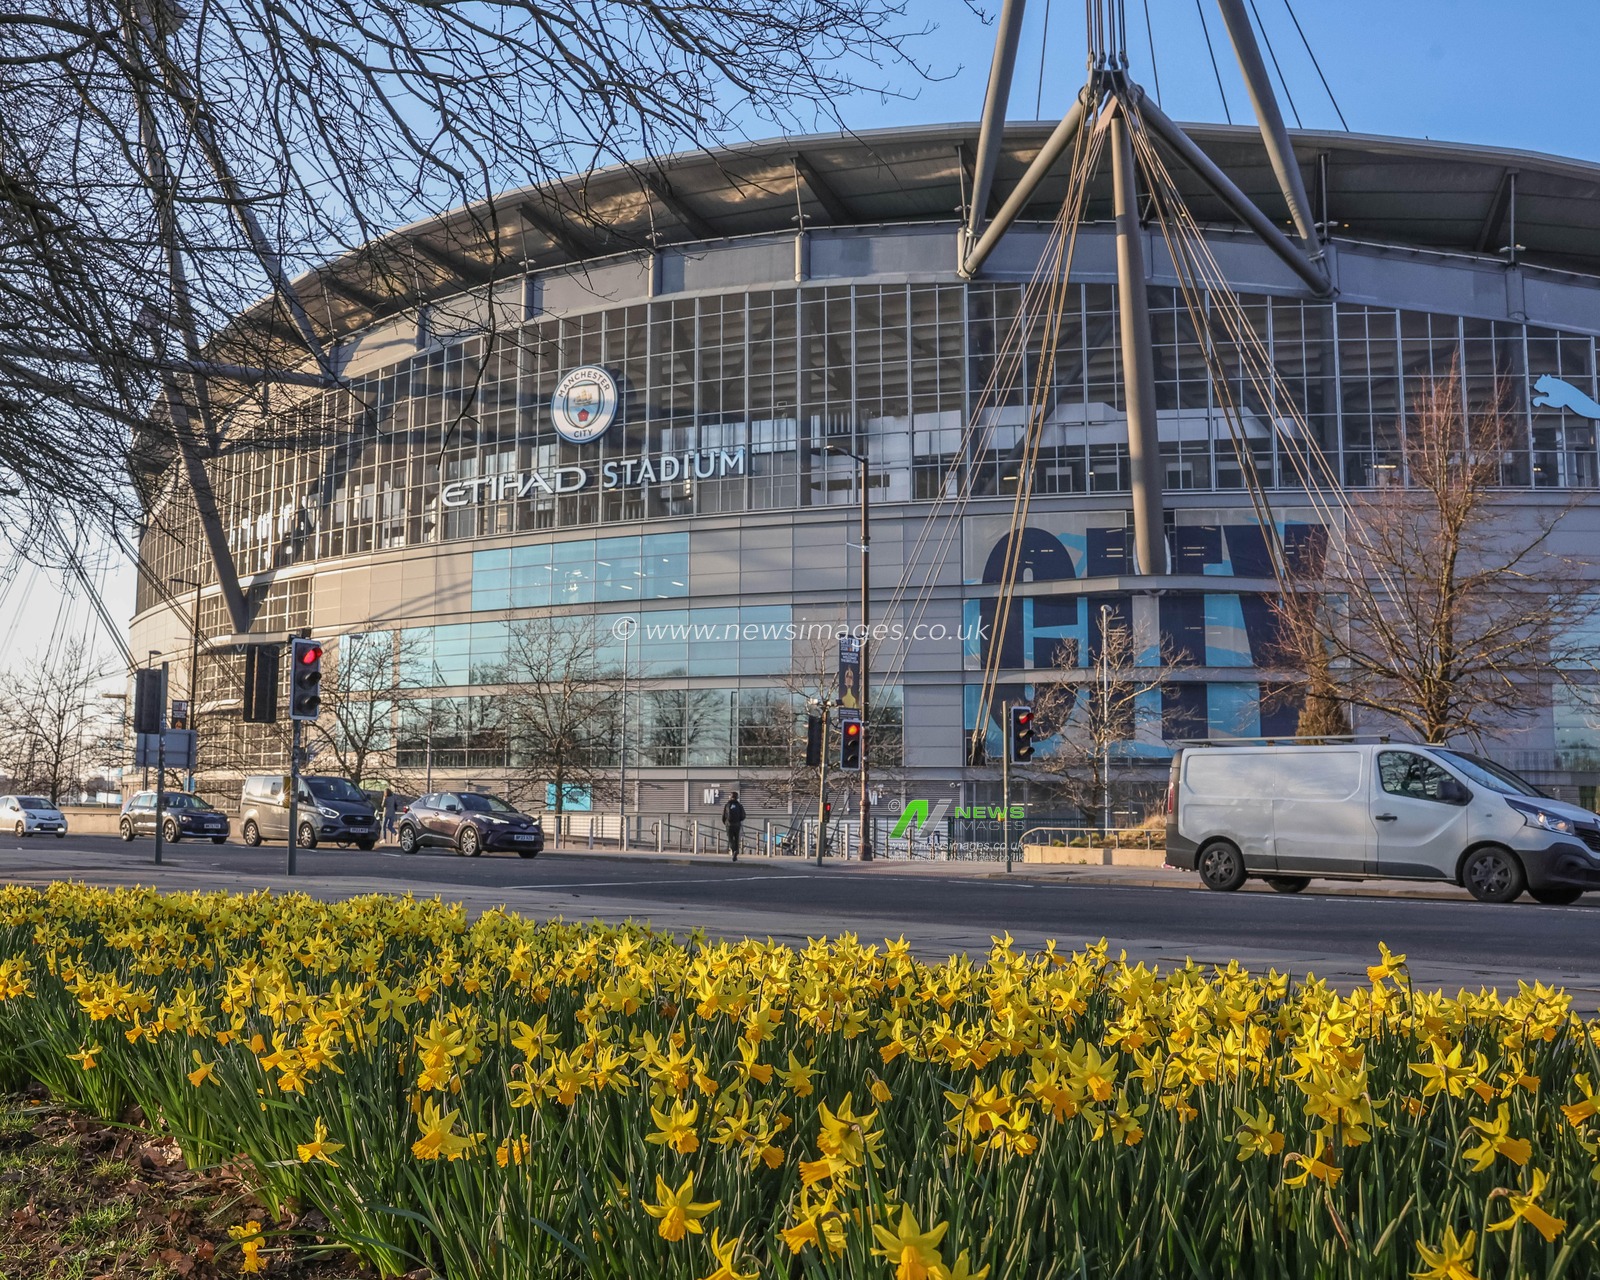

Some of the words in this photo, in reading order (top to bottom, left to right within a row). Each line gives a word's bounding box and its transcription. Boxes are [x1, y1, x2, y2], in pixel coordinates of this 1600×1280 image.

[558, 371, 610, 398] MANCHESTER
[573, 429, 593, 438] CITY
[441, 466, 588, 507] ETIHAD
[603, 448, 745, 489] STADIUM
